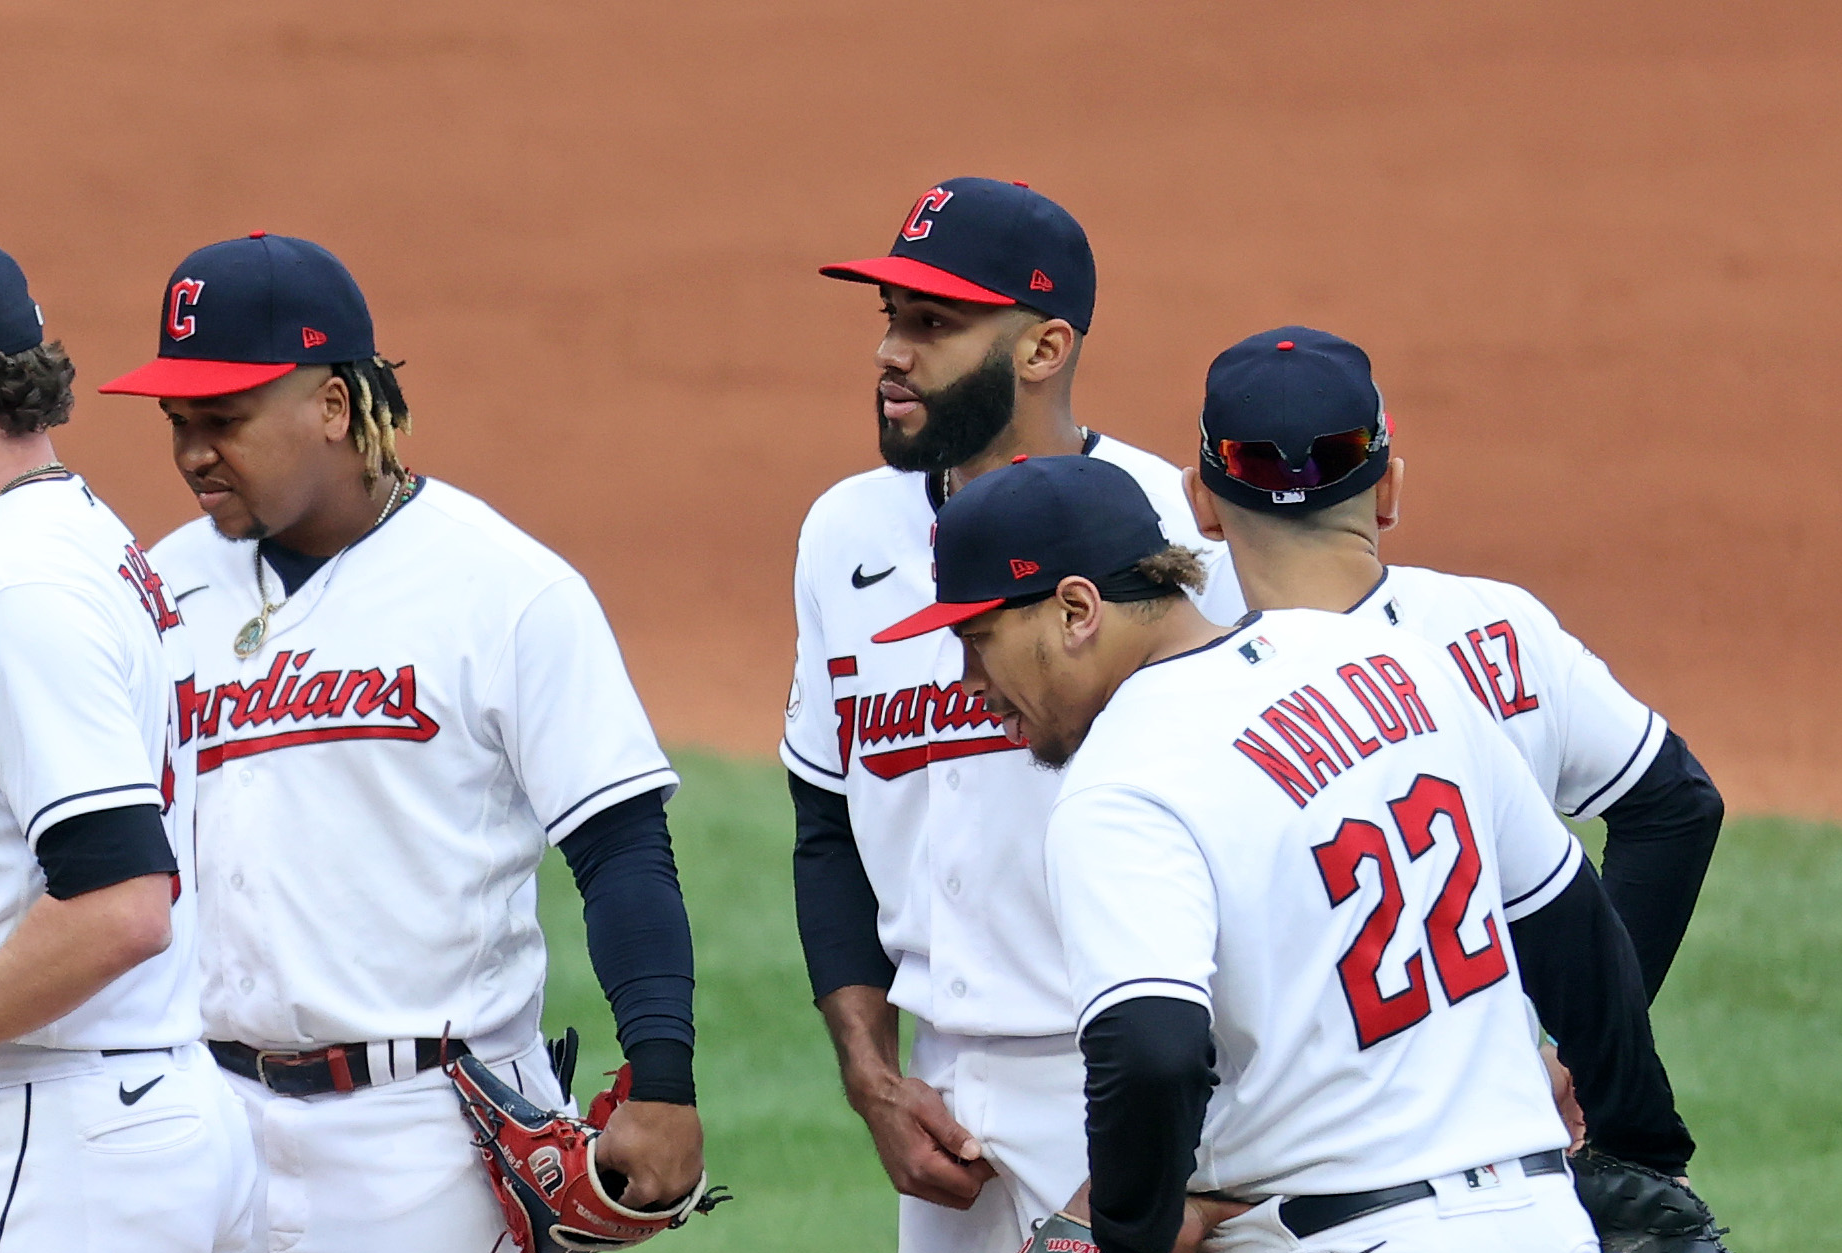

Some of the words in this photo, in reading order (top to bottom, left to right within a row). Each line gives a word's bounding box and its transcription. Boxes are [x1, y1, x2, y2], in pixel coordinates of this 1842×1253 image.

[901, 186, 954, 242] C
[166, 277, 205, 342] C
[1233, 654, 1438, 809] NAYLOR
[1311, 773, 1509, 1051] 22
